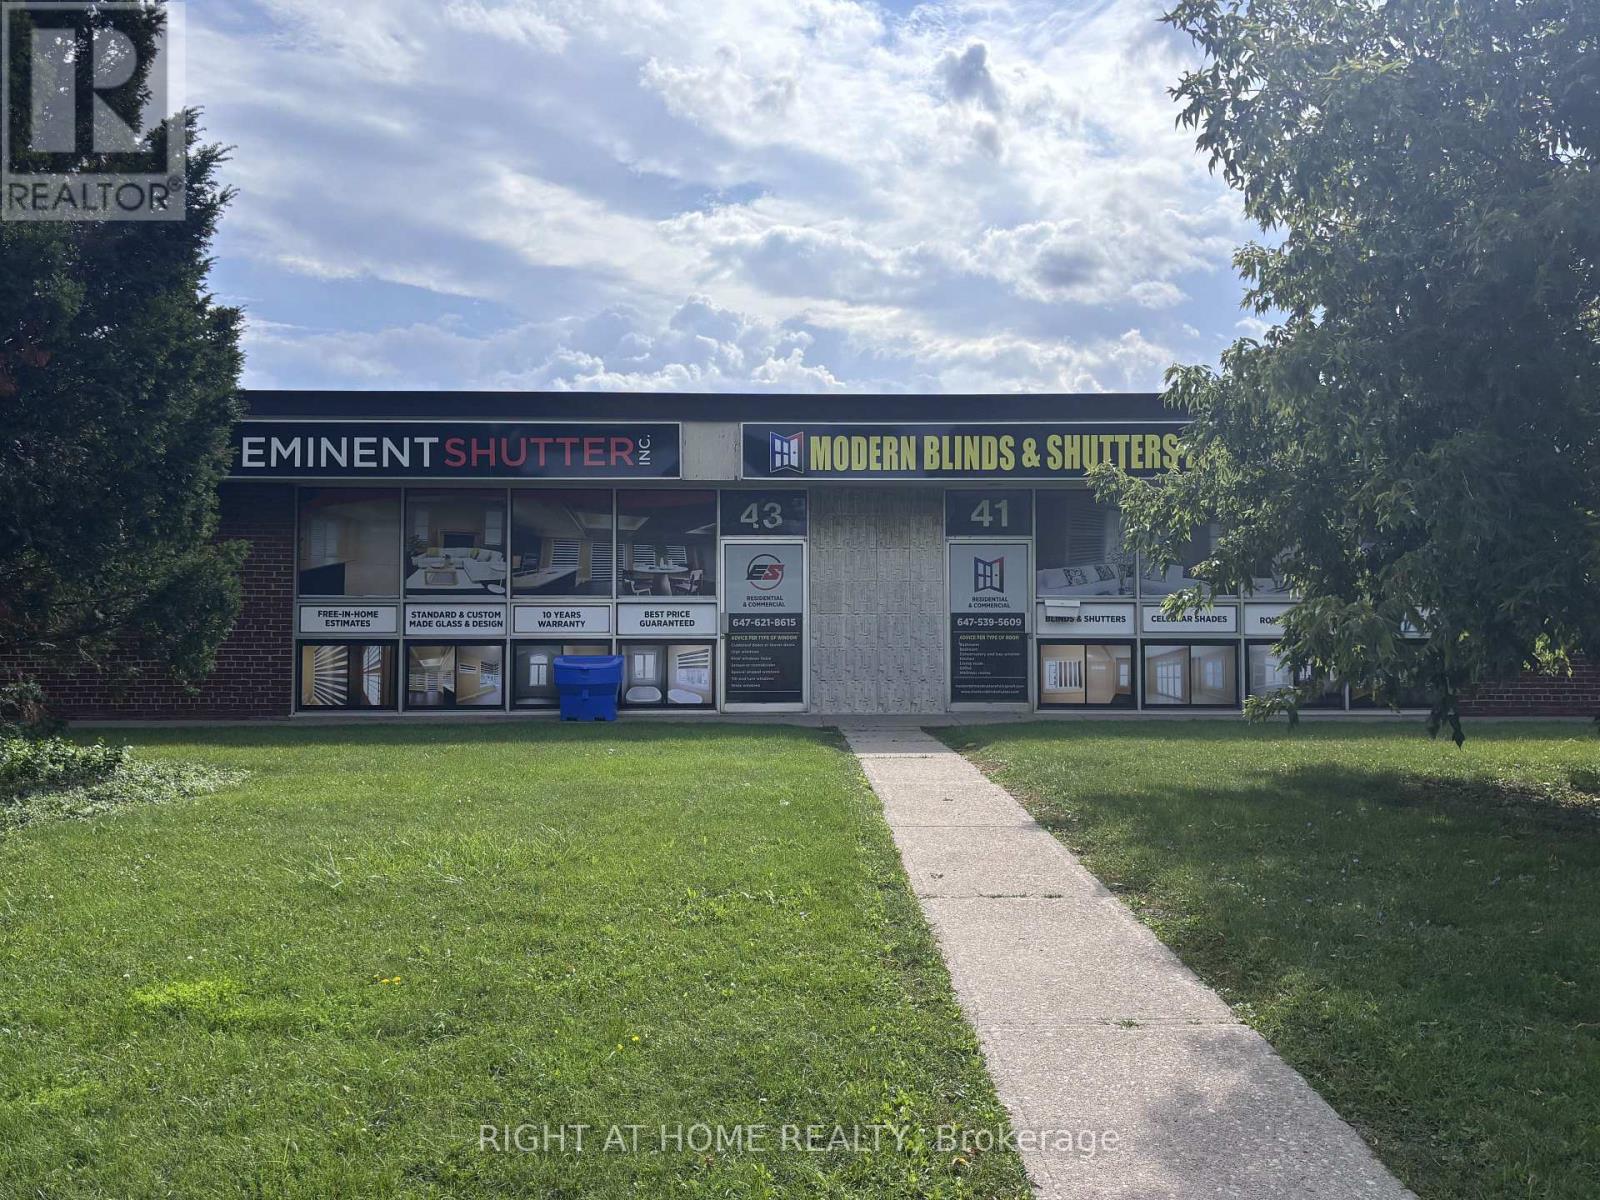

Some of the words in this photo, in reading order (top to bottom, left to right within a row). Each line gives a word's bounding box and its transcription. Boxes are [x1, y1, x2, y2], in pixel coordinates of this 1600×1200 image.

[242, 437, 438, 468] EMINENT
[444, 437, 634, 467] SHUTTER
[639, 434, 652, 465] INC.
[810, 435, 916, 471] MODERN
[923, 435, 1015, 471] BLINDS
[1022, 437, 1041, 468] &
[1046, 433, 1179, 470] SHUTTERS
[740, 502, 783, 529] 43
[970, 499, 1008, 527] 41
[317, 610, 379, 618] FREE-IN-HOME
[411, 611, 456, 619] STANDARD
[458, 611, 465, 619] &
[466, 611, 501, 619] CUSTOM
[542, 611, 551, 619] 10
[553, 611, 581, 619] YEARS
[644, 610, 664, 618] BEST
[666, 610, 691, 618] PRICE
[325, 619, 371, 627] ESTIMATES
[639, 619, 695, 627] GUARANTEED
[732, 618, 797, 627] 647-621-8615
[957, 617, 1022, 626] 647-539-5609
[1083, 615, 1127, 623] SHUTTERS
[1194, 615, 1228, 623] SHADES
[409, 620, 433, 628] MADE
[435, 620, 463, 628] GLASS
[464, 620, 470, 628] &
[472, 620, 503, 628] DESIGN
[537, 620, 586, 628] WARRANTY
